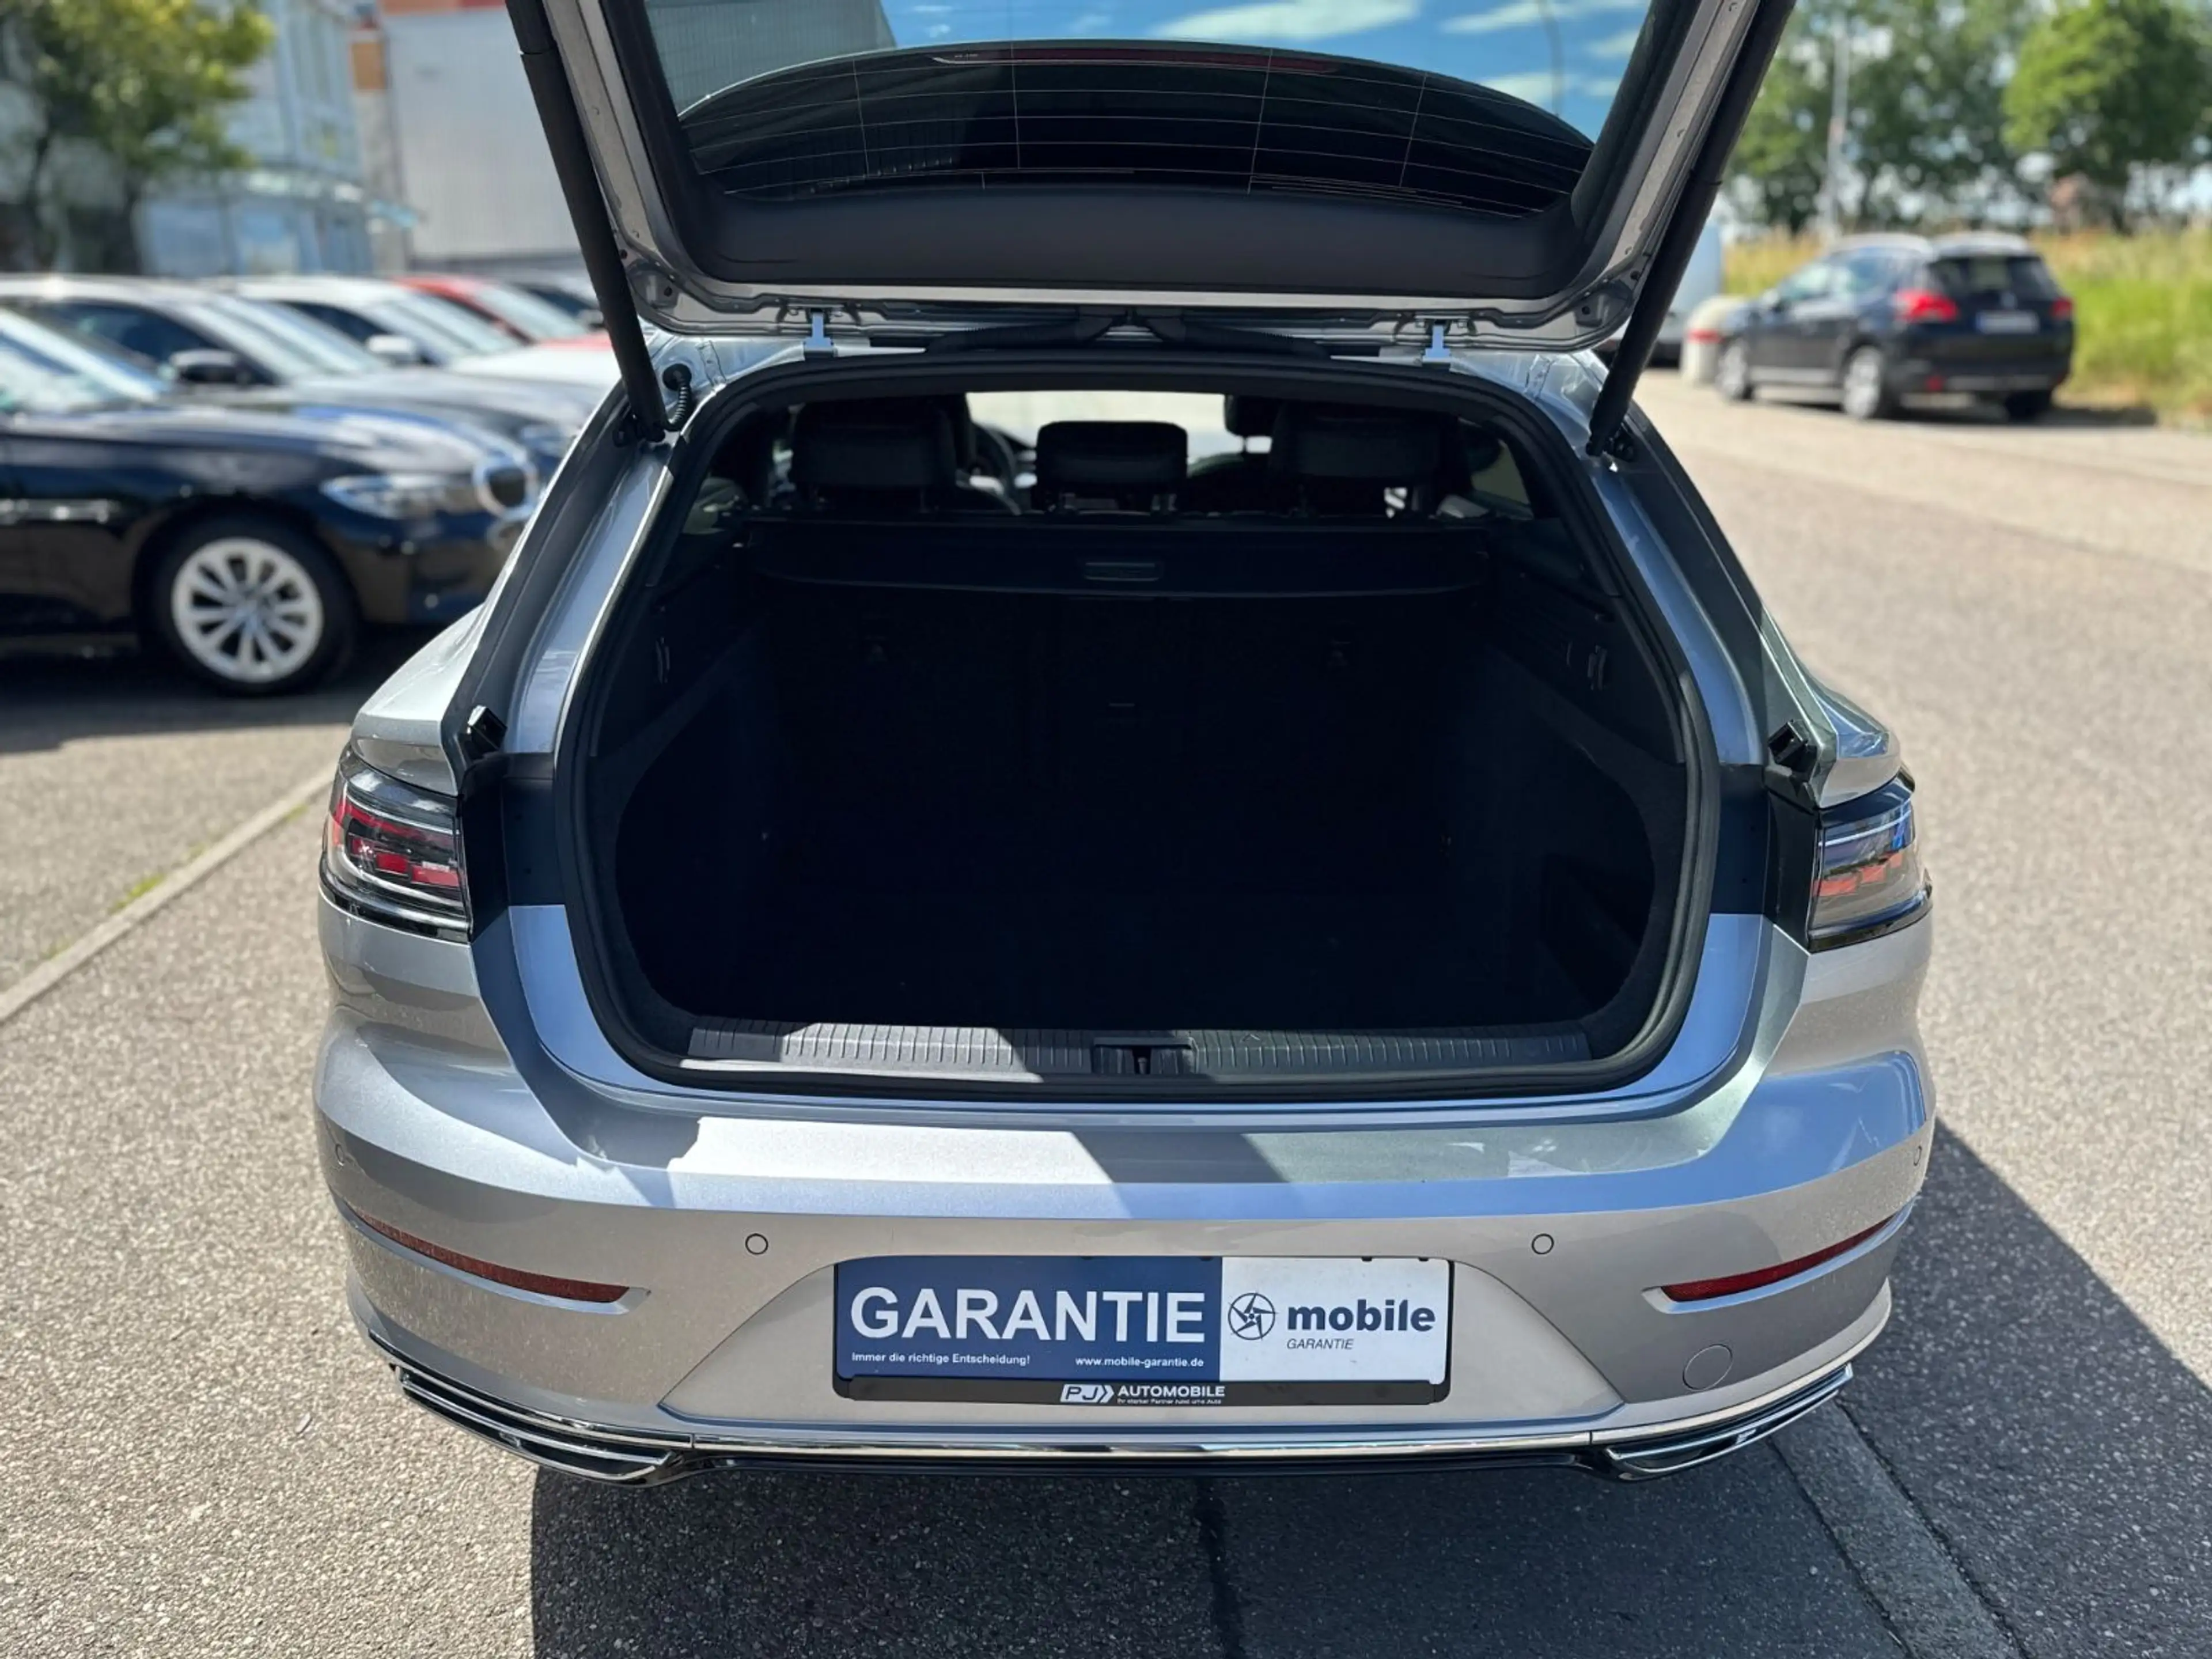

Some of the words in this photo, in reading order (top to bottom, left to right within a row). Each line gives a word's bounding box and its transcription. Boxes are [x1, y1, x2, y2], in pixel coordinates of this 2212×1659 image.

[851, 1287, 1205, 1343] GARANTIE
[1287, 1299, 1435, 1332] mobile
[1287, 1338, 1354, 1350] GARANTIE
[851, 1352, 885, 1362] Immer
[889, 1353, 906, 1362] die
[908, 1353, 949, 1365] richtige
[952, 1354, 1031, 1366] Entscheidung!
[1075, 1356, 1204, 1369] www.mobile-garantie.de
[1118, 1385, 1225, 1397] AUTOMOBILE
